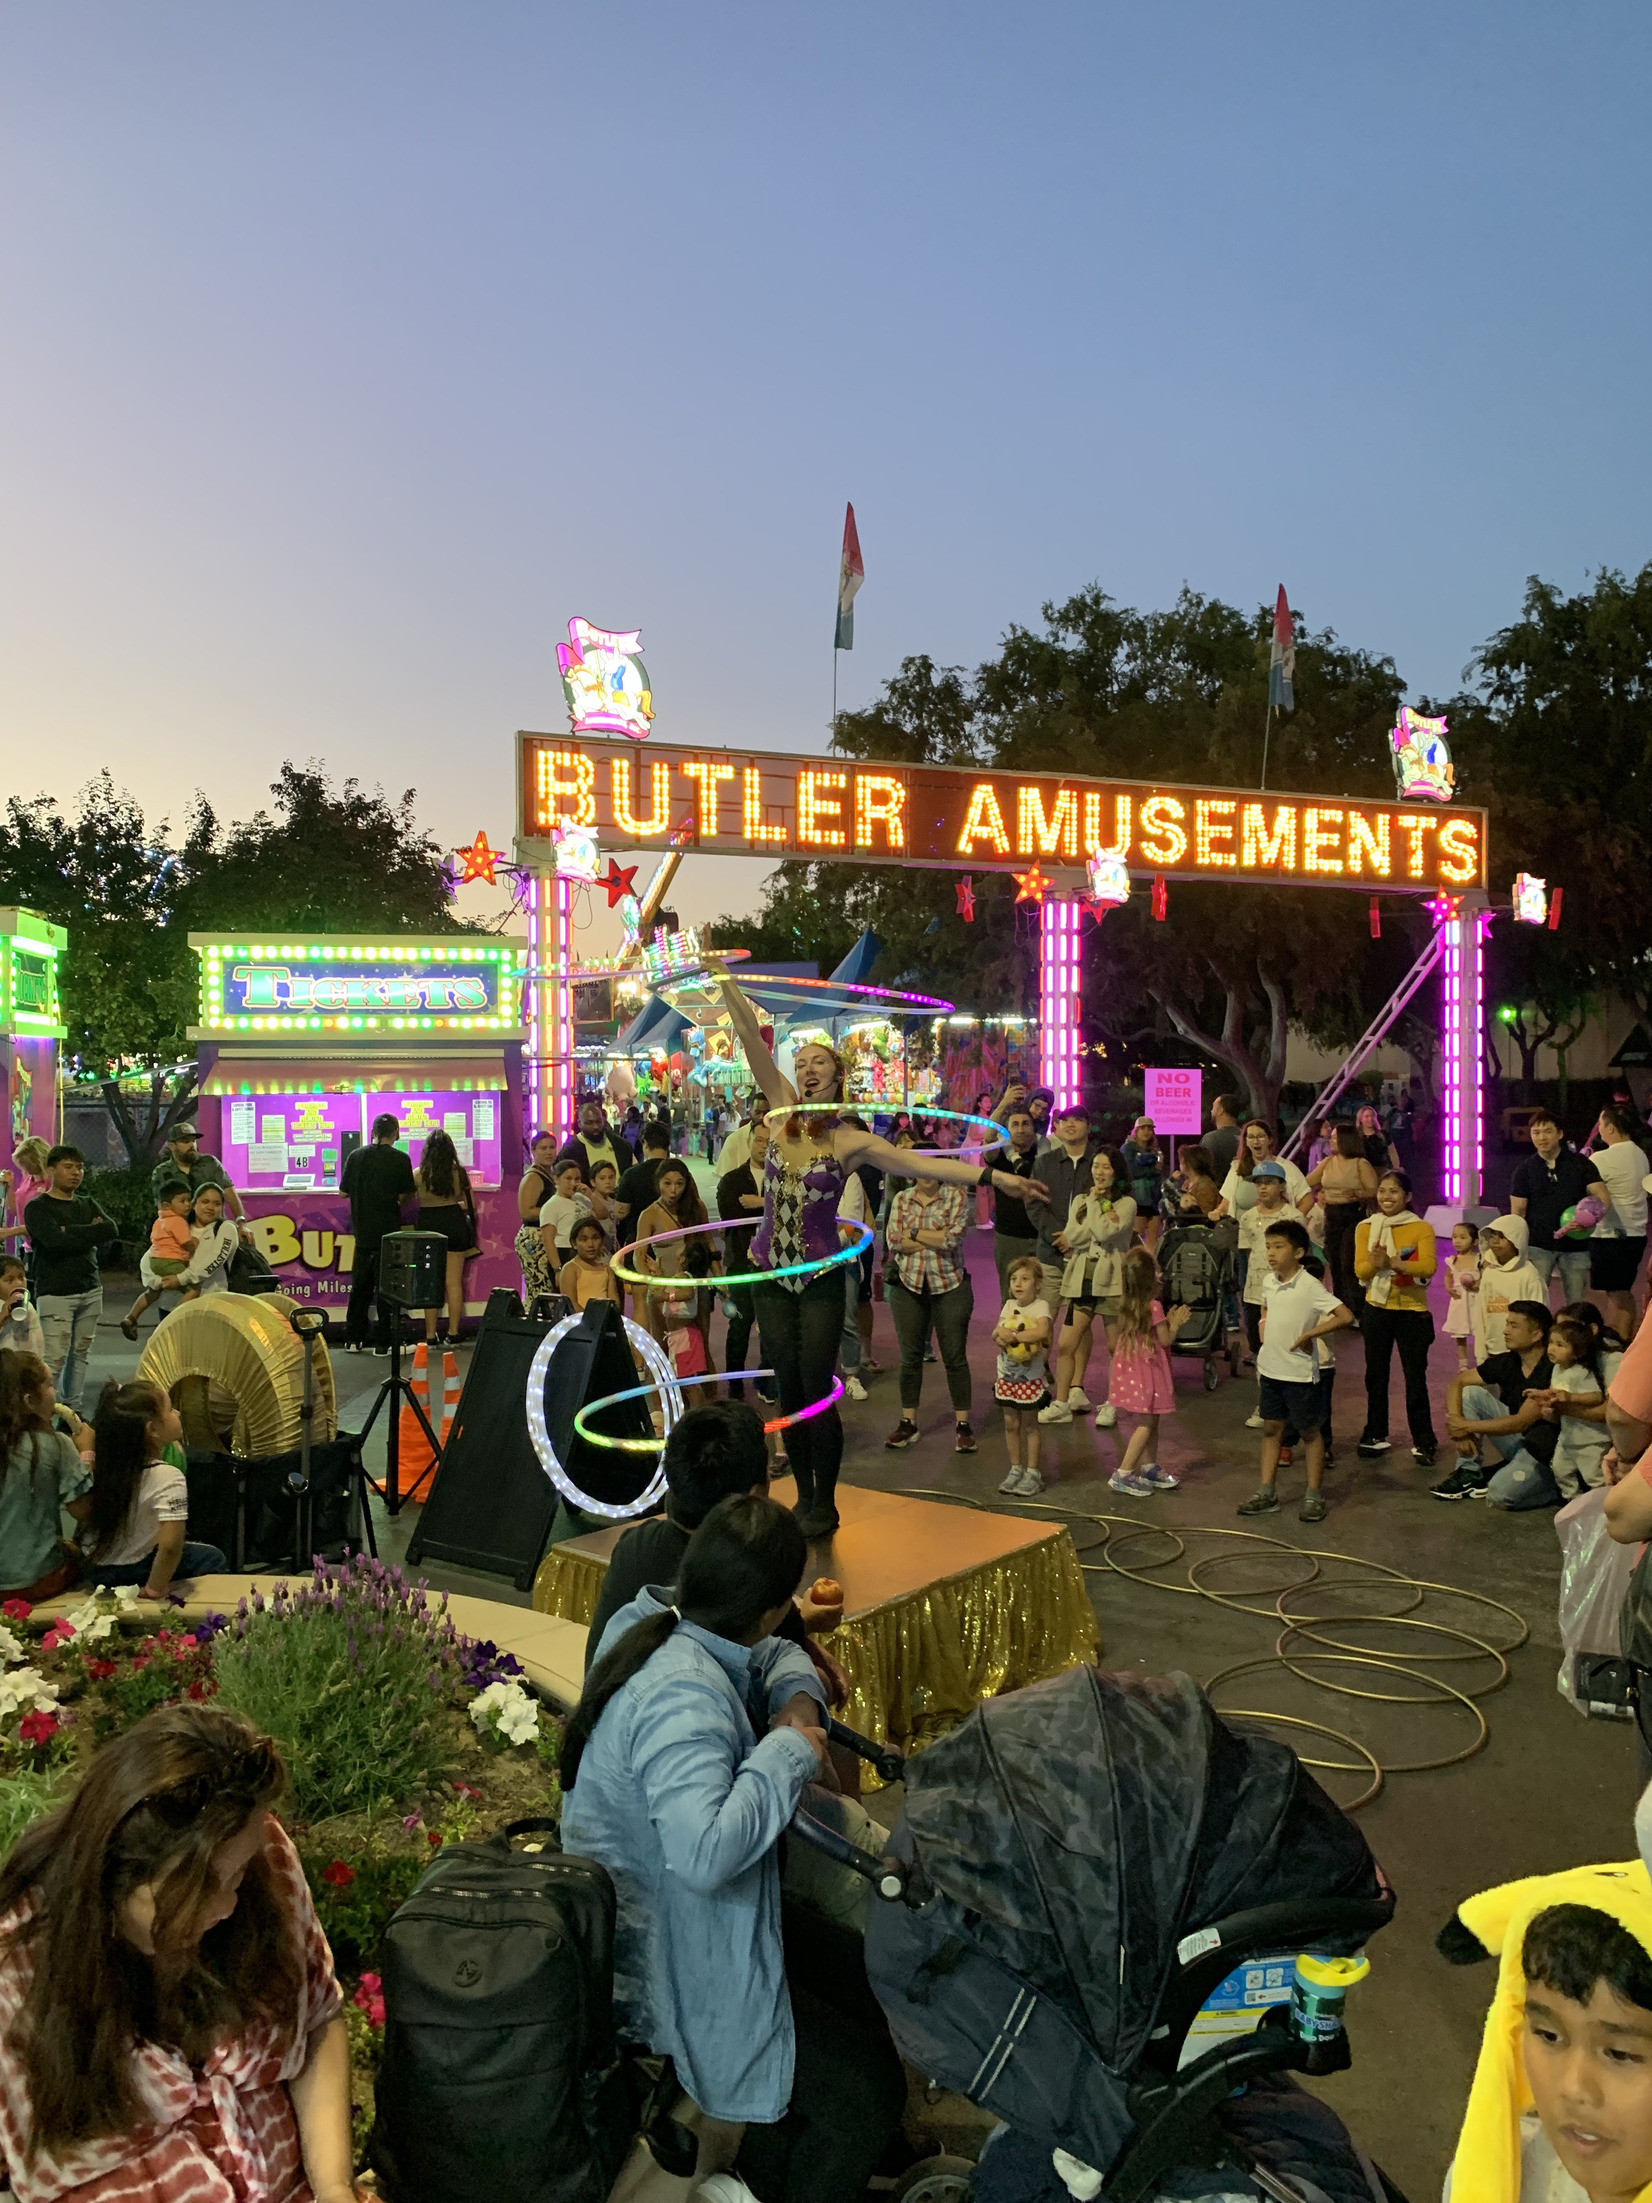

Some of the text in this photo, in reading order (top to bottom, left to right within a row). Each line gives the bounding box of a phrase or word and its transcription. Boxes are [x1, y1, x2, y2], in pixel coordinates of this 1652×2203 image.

[536, 749, 1479, 883] BUTLER AMUSEMENTS
[233, 965, 487, 1009] TICKETS
[1157, 1073, 1190, 1084] NO
[1156, 1087, 1191, 1098] BEER
[296, 1157, 308, 1168] 4B
[204, 1237, 232, 1275] HOLLISTER
[275, 1280, 353, 1298] Going Miles
